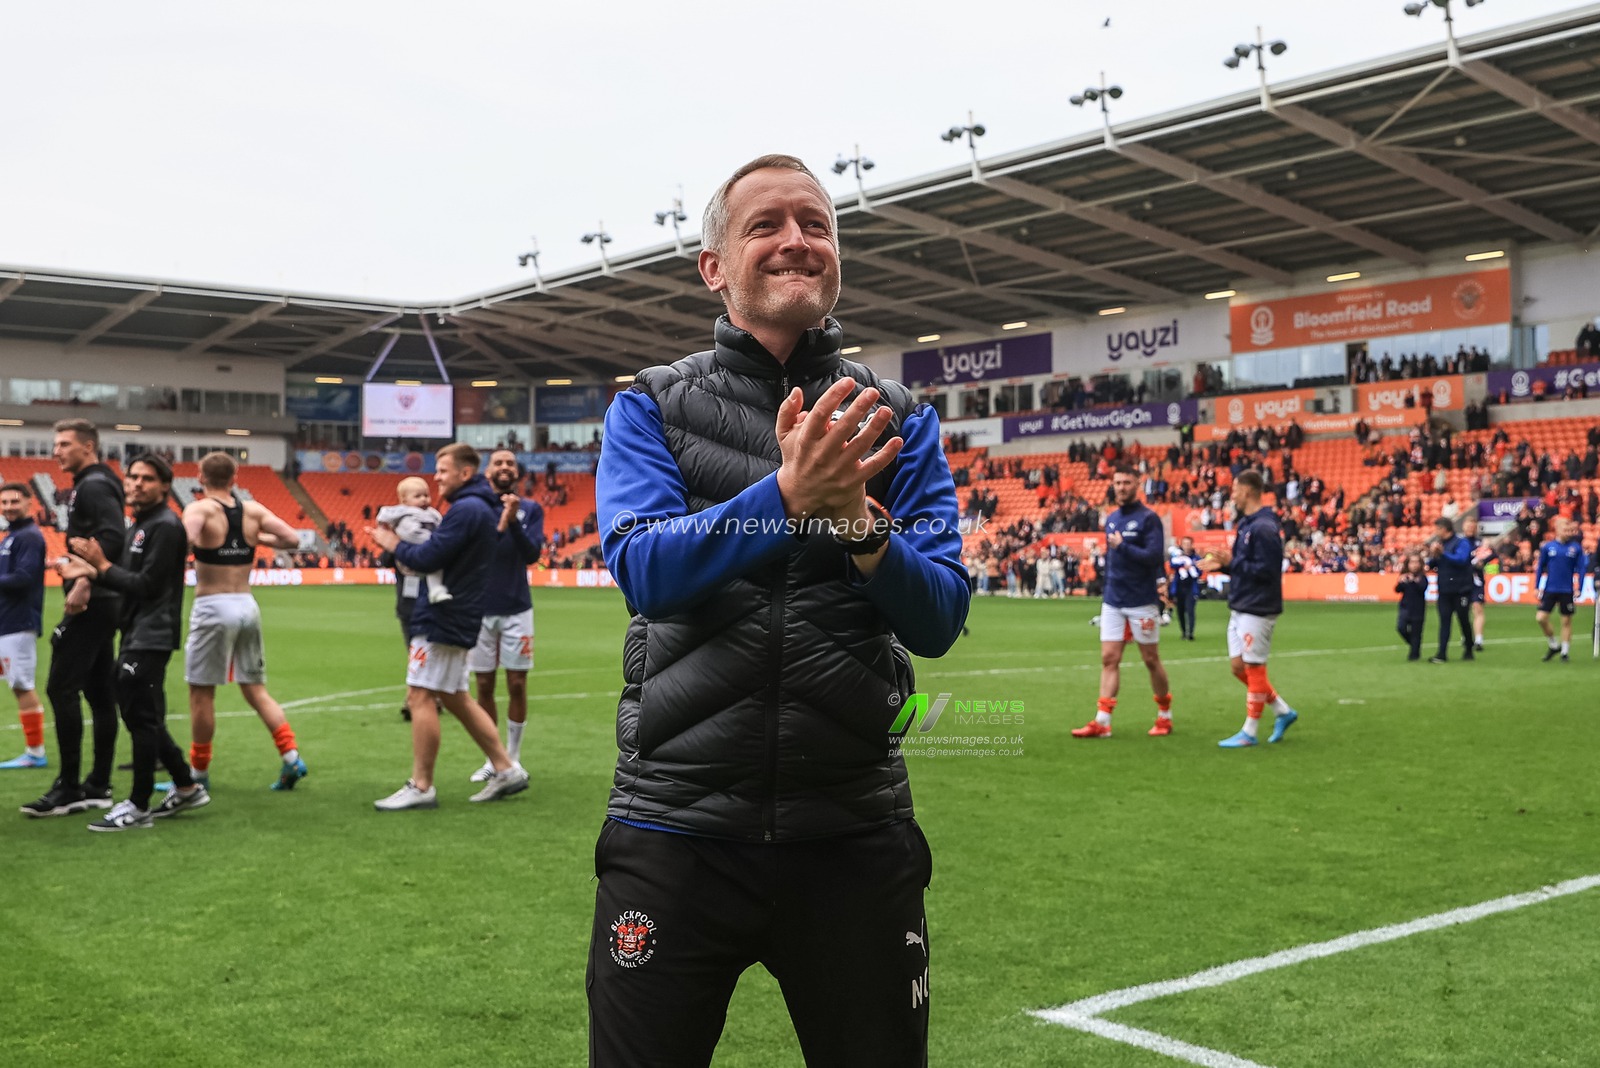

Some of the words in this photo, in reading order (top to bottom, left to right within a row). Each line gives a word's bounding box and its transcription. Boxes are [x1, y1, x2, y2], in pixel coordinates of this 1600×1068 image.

[1293, 302, 1383, 329] Bloomfield
[1385, 295, 1432, 318] Road
[1107, 319, 1178, 361] yayzi
[942, 344, 1002, 382] yayzi
[1554, 368, 1600, 389] #Ge
[1051, 408, 1152, 431] #GetYourGigOn
[1254, 396, 1300, 420] yayzi
[1488, 575, 1530, 602] OF
[1243, 633, 1255, 650] 9
[611, 910, 657, 935] BLACKPOOL
[610, 947, 637, 968] FOOTBALL
[638, 949, 654, 965] CLUB
